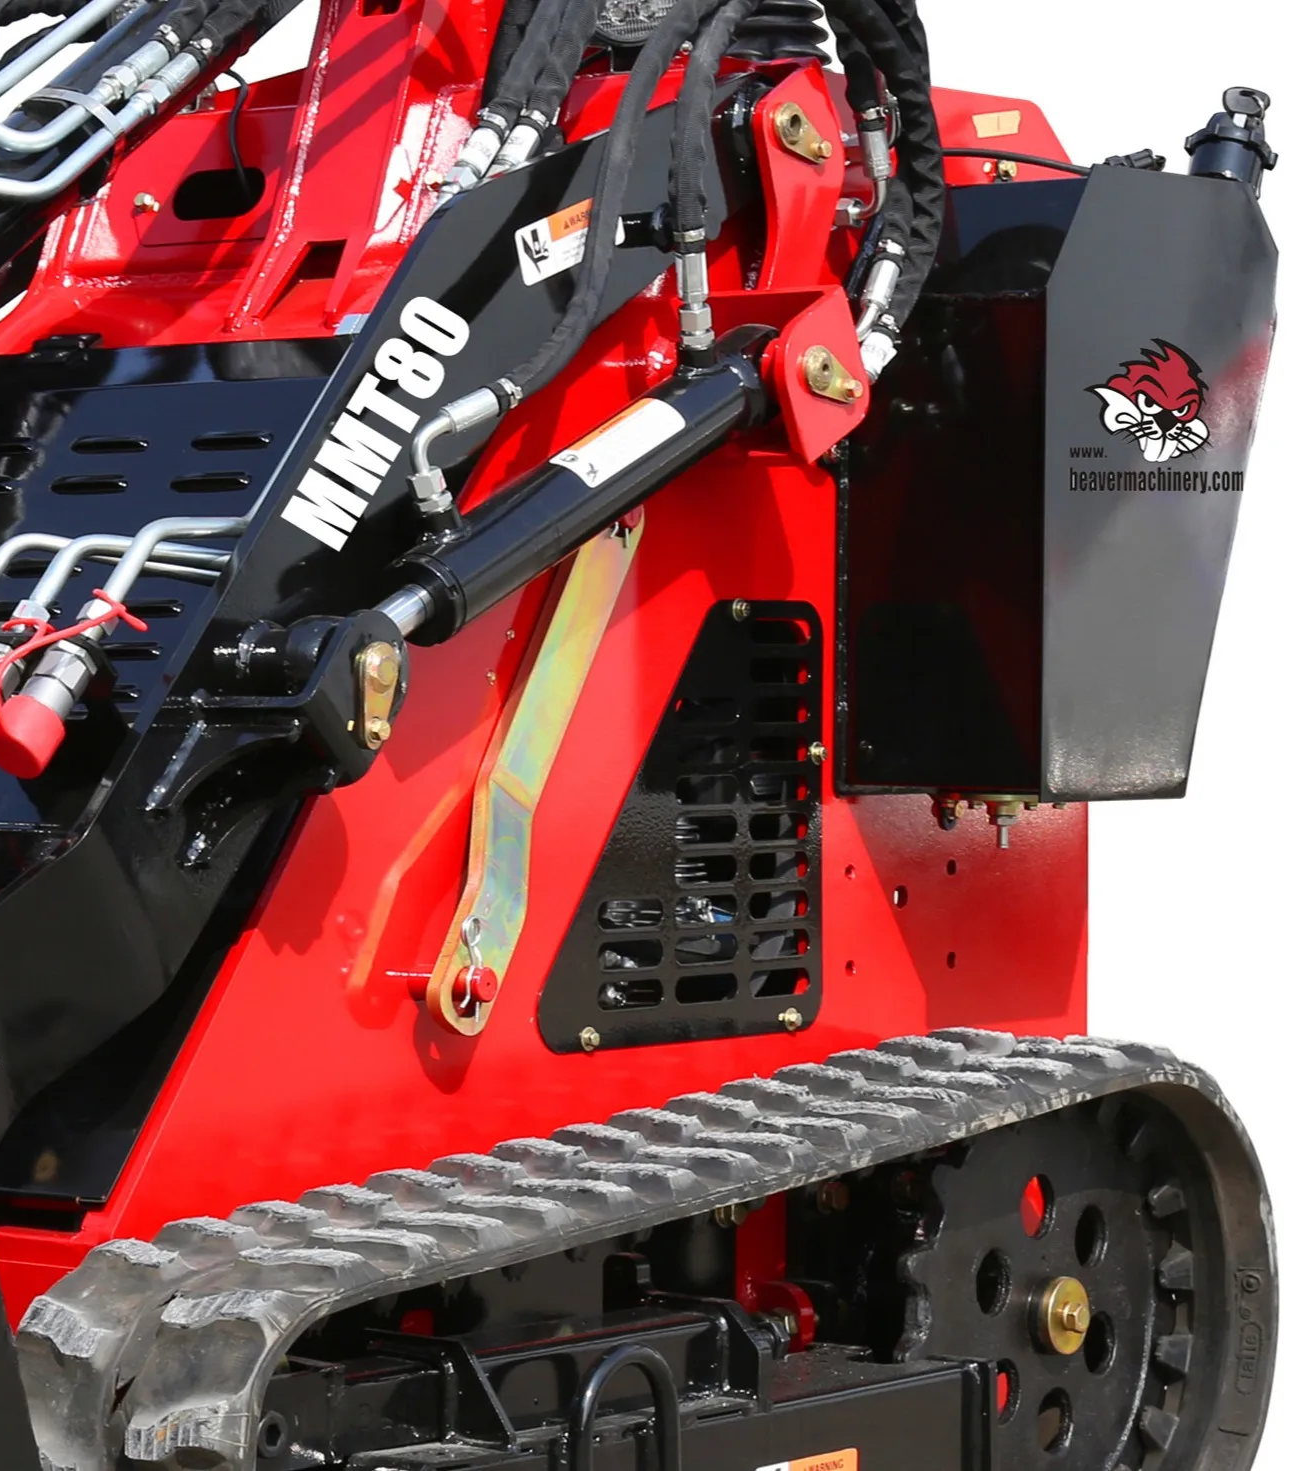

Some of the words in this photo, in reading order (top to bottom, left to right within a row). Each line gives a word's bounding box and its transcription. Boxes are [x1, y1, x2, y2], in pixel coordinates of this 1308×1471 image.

[280, 296, 470, 552] MMT80
[1069, 447, 1108, 459] www.
[1069, 467, 1244, 494] beavermachinery.com
